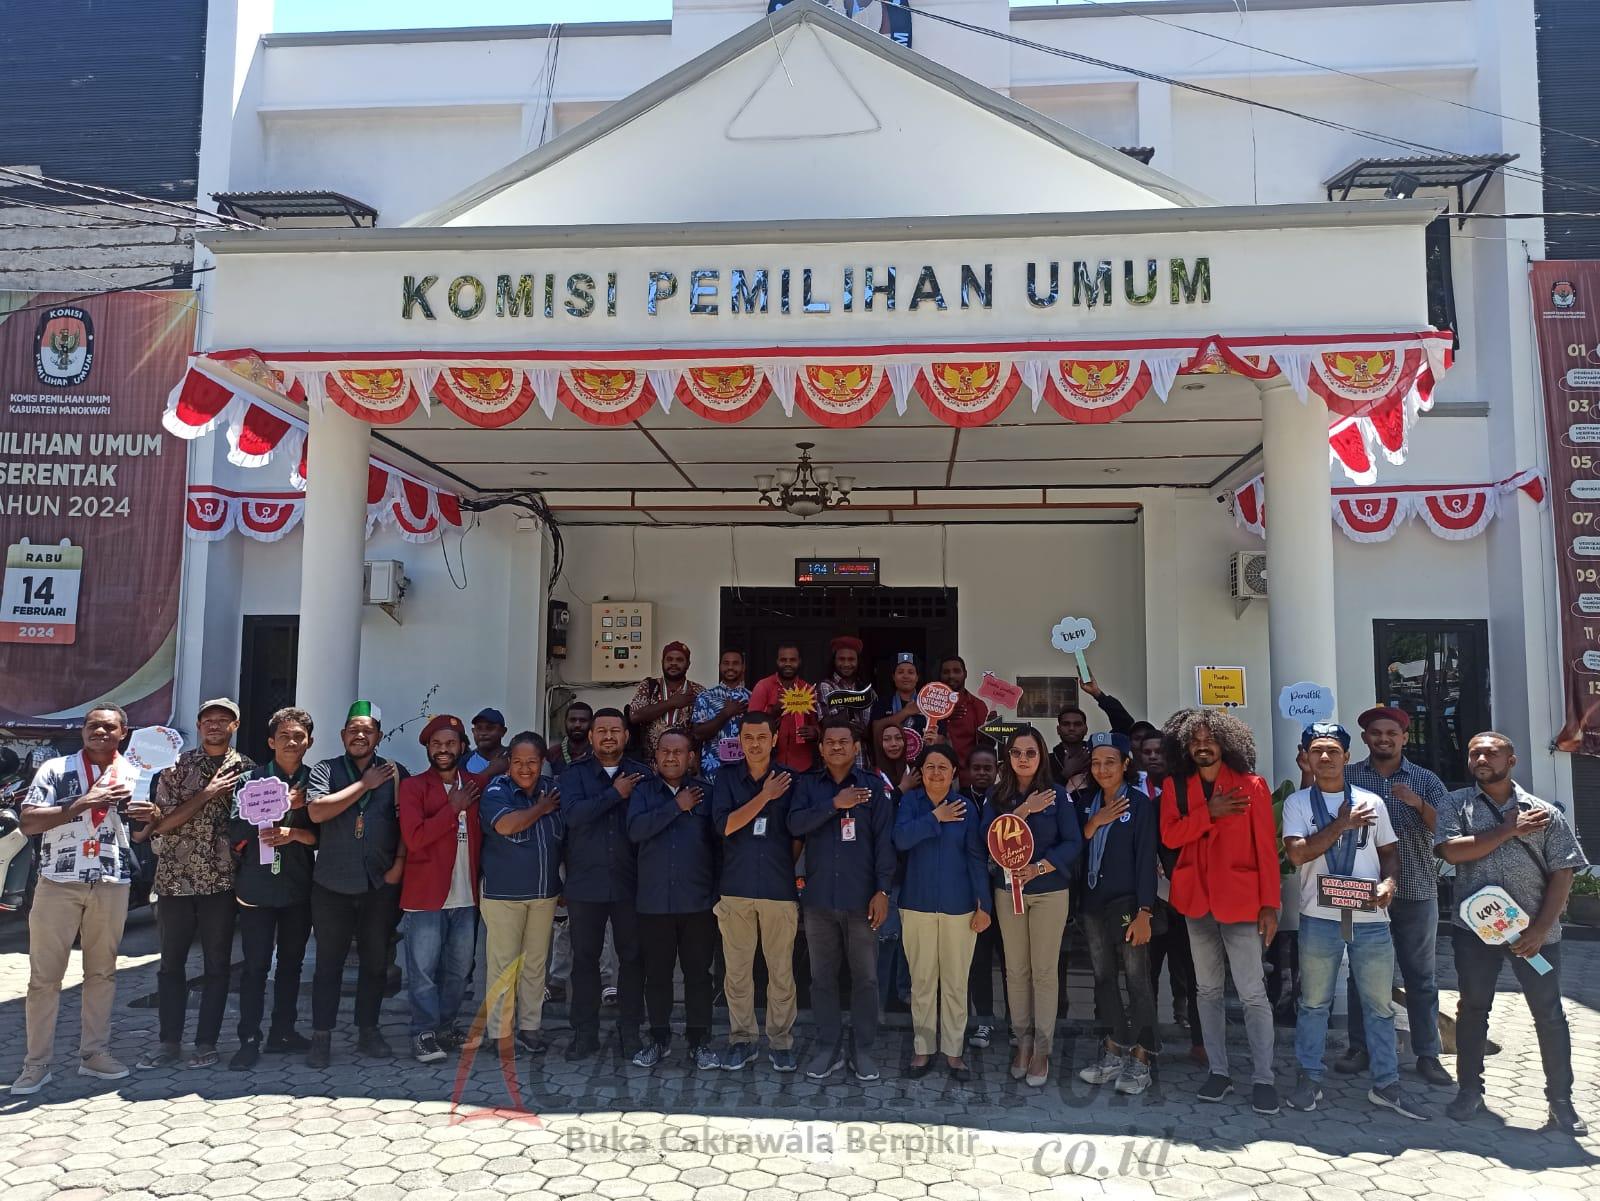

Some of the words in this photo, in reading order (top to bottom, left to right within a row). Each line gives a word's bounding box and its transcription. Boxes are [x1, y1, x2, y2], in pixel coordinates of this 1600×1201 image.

[401, 271, 618, 320] KOMISI
[647, 263, 993, 316] PEMILIHAN
[1027, 257, 1211, 310] UMUM
[50, 308, 83, 320] KOMISI
[1567, 343, 1587, 357] 01
[73, 354, 93, 385] UMUM
[1568, 399, 1590, 413] 03
[90, 433, 163, 457] UMUM
[1571, 456, 1592, 469] 05
[68, 496, 131, 518] 2024
[1572, 512, 1593, 525] 07
[26, 553, 62, 563] RABU
[22, 575, 55, 605] 14
[12, 606, 67, 617] FEBRUARI
[18, 626, 55, 638] 2024
[1584, 627, 1595, 640] 11
[991, 816, 1025, 854] 14
[1007, 854, 1026, 866] 2024
[1321, 877, 1343, 887] SAYA
[1343, 880, 1372, 891] SUDAH
[1475, 900, 1503, 921] KPU
